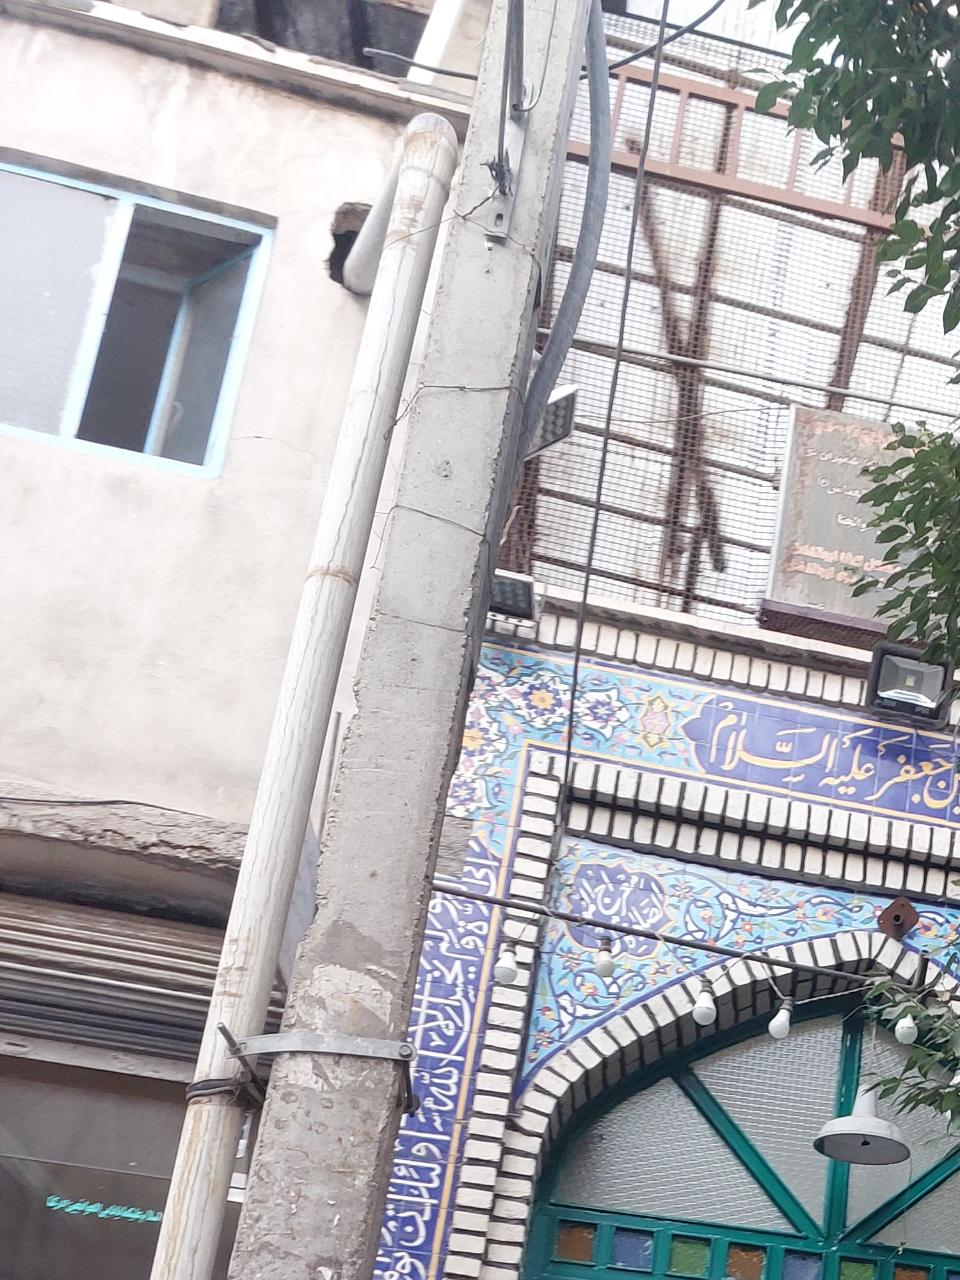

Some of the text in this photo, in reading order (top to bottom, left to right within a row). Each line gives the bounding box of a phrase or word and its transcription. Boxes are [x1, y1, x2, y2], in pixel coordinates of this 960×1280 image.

[710, 704, 839, 780] السلام
[819, 732, 876, 795] علیه
[864, 746, 955, 804] جعفر
